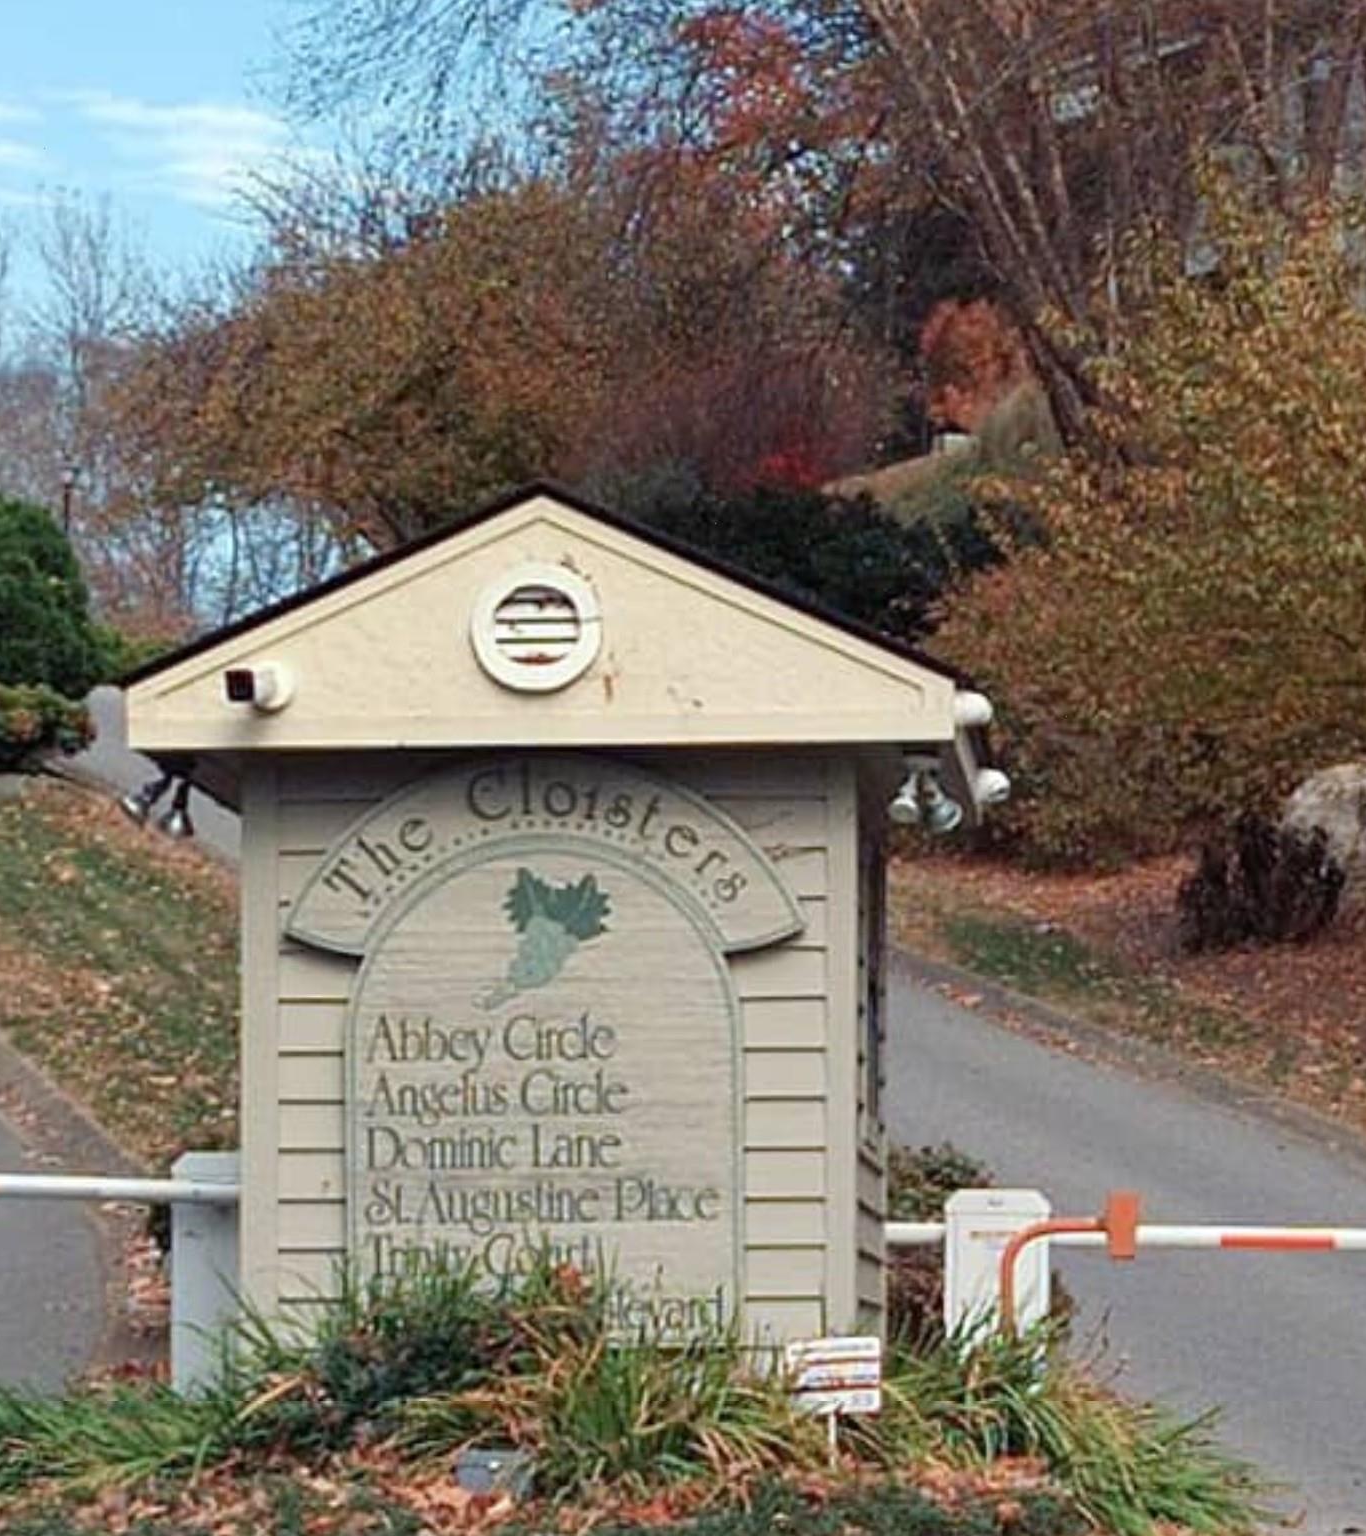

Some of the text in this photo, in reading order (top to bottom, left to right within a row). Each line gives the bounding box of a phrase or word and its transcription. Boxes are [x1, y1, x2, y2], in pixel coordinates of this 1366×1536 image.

[323, 761, 747, 904] The Cloisters
[365, 1011, 615, 1071] Abbey Circle
[364, 1066, 629, 1127] Angelus Circle
[366, 1123, 622, 1170] Dominic Lane
[612, 1176, 721, 1222] Place
